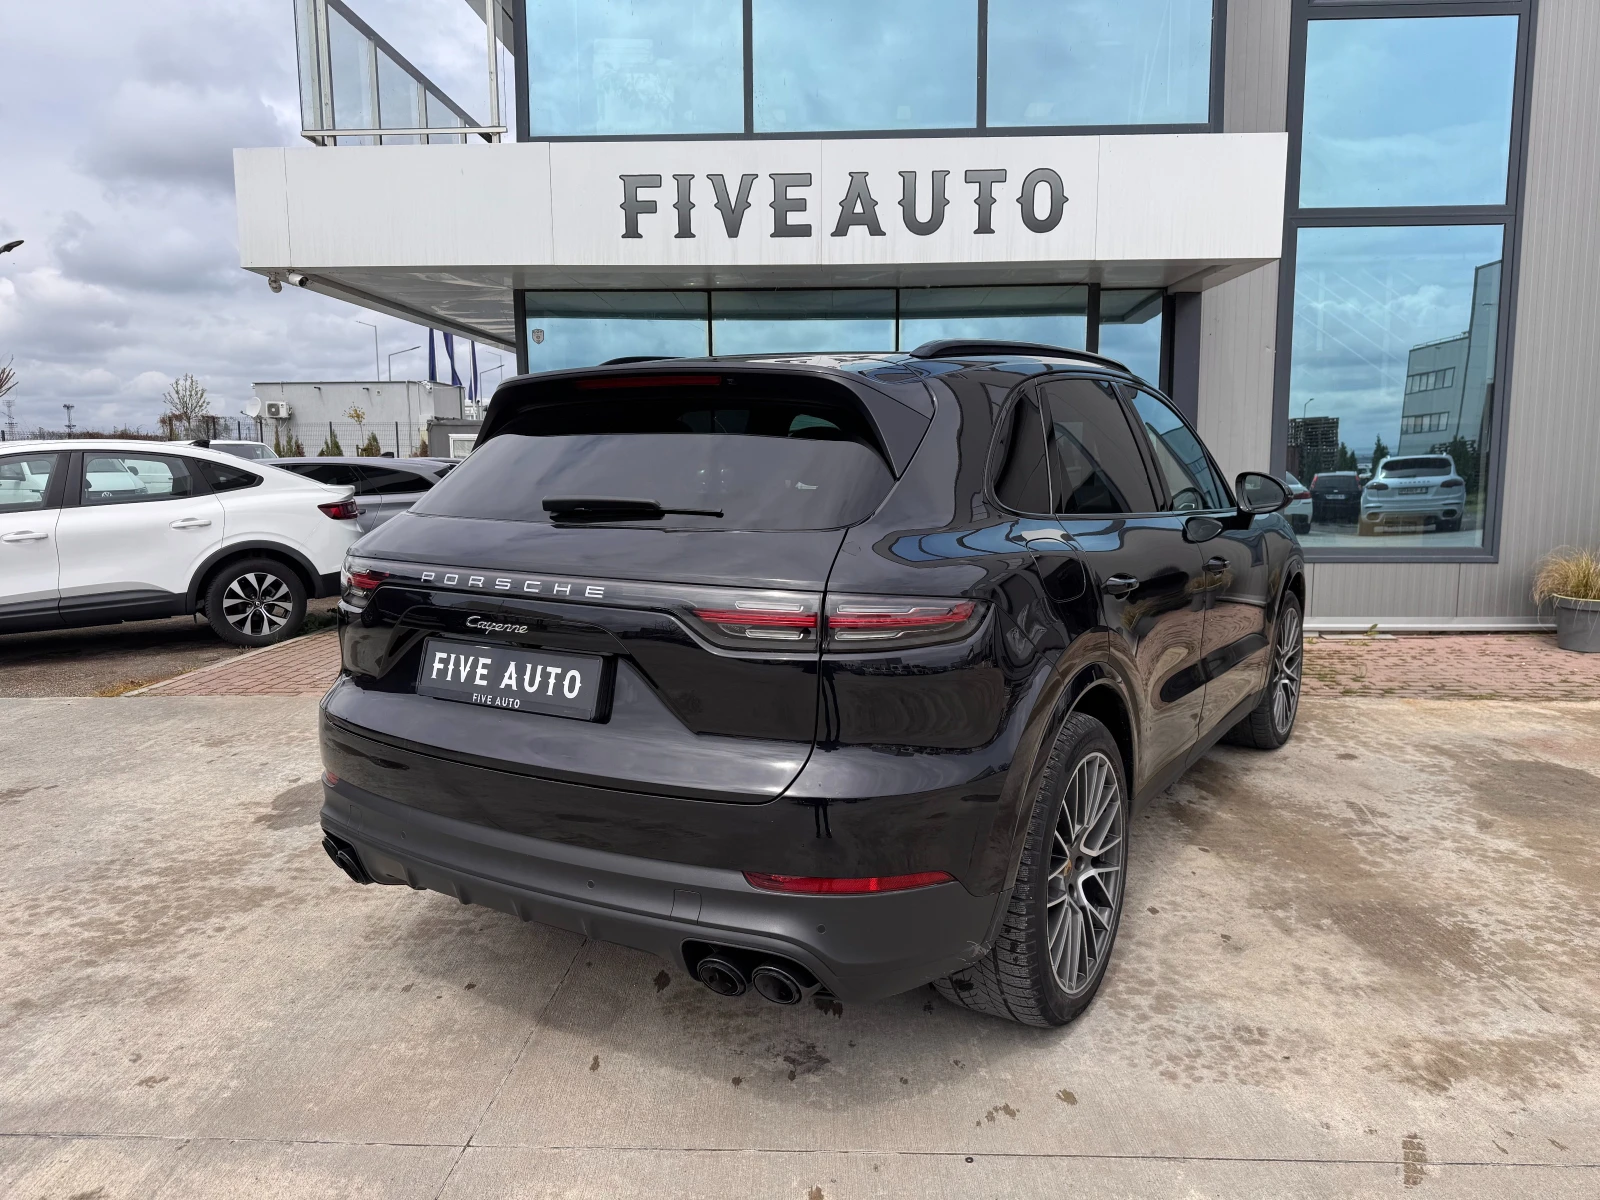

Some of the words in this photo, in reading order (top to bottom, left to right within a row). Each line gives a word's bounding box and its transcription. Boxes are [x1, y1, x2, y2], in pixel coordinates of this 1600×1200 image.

[619, 173, 812, 238] FIVE
[830, 168, 1069, 236] AUTO
[421, 571, 605, 598] PORSCHE
[466, 615, 528, 634] Cayenne
[430, 651, 492, 686] FIVE
[499, 661, 582, 699] AUTO
[472, 693, 492, 705] FIVE
[495, 696, 520, 708] AUTO
